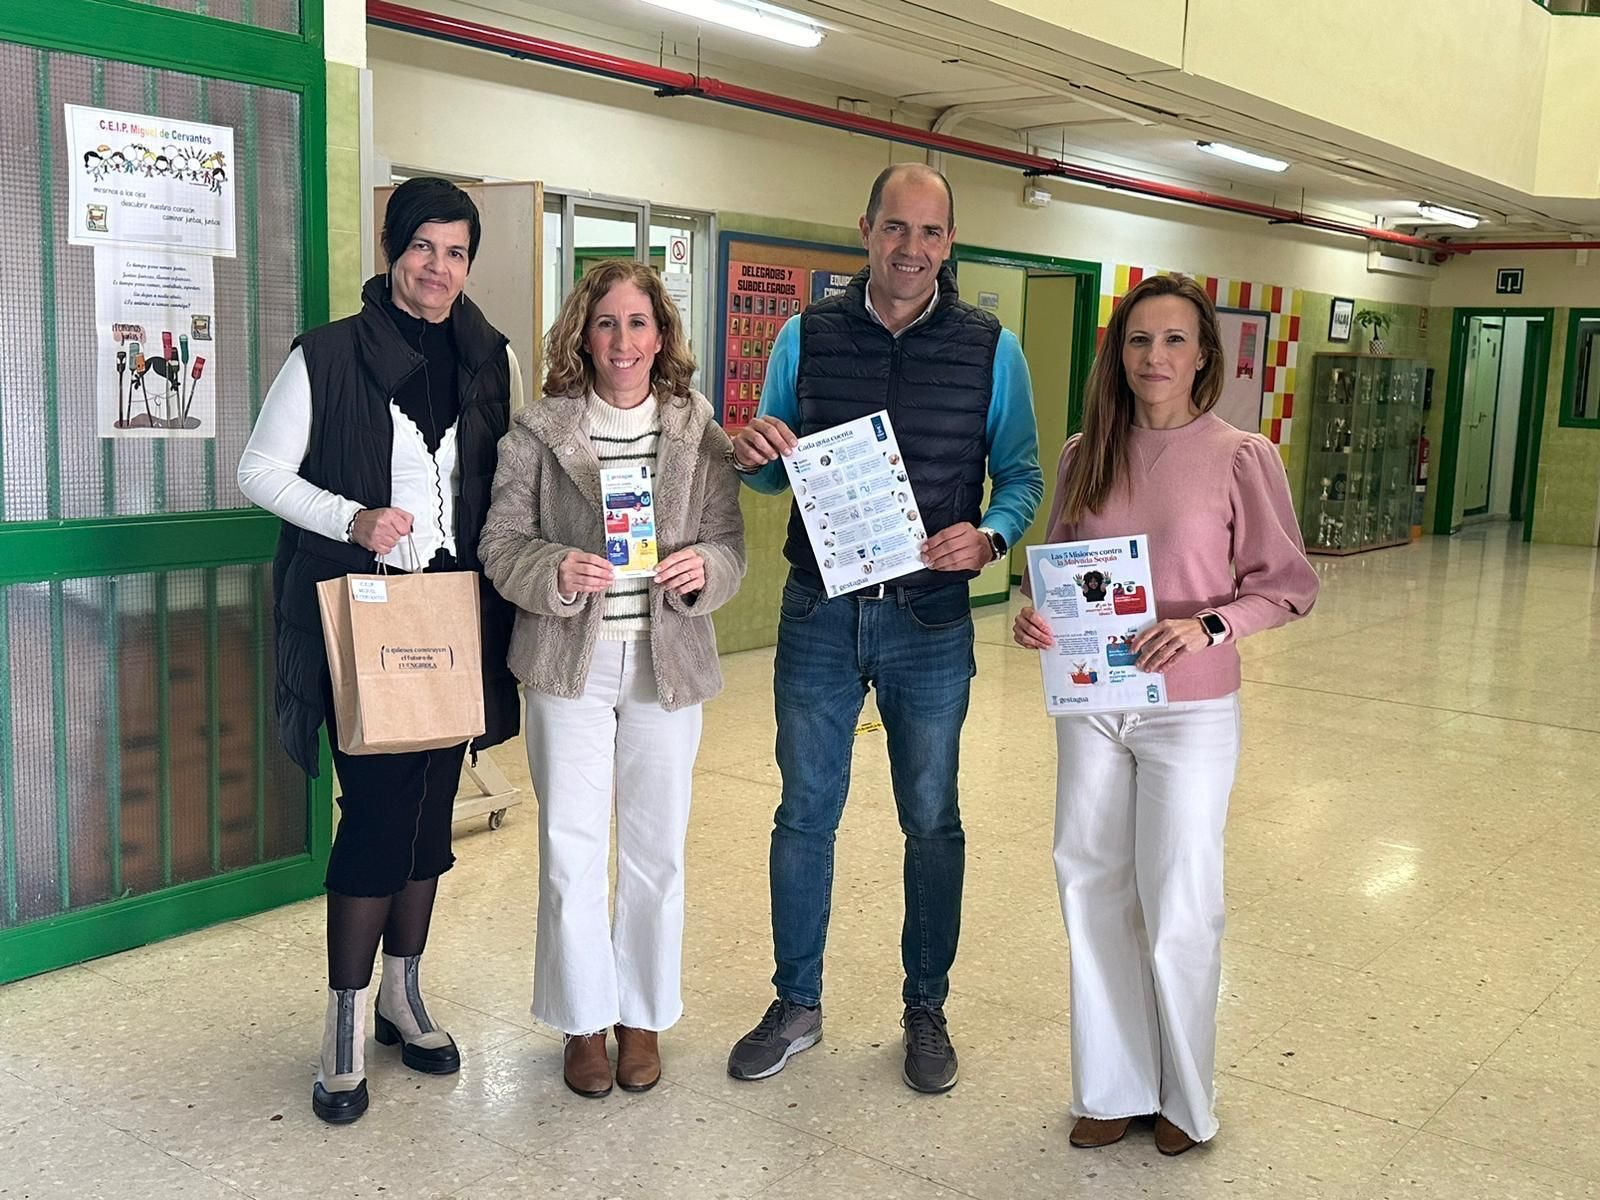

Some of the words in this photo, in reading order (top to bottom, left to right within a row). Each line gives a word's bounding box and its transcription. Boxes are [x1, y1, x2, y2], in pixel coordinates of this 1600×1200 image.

[99, 120, 129, 134] C.E.I.P.
[130, 124, 158, 138] Miguel
[160, 129, 170, 139] de
[172, 130, 212, 145] Cervantes
[742, 266, 786, 280] DELEGAD@S
[788, 270, 792, 281] Y
[830, 274, 853, 287] EQUIP
[738, 280, 796, 295] SUBDELEGAD@S
[798, 442, 815, 452] Cada
[816, 438, 830, 447] gota
[830, 430, 854, 442] cuenta
[614, 542, 620, 552] 4
[642, 539, 648, 548] 5
[1051, 552, 1062, 560] Las
[1068, 550, 1098, 558] Misiones
[1100, 548, 1122, 556] contra
[1064, 558, 1092, 566] Malvada
[839, 577, 868, 591] gestagua
[1058, 695, 1088, 705] gestagua
